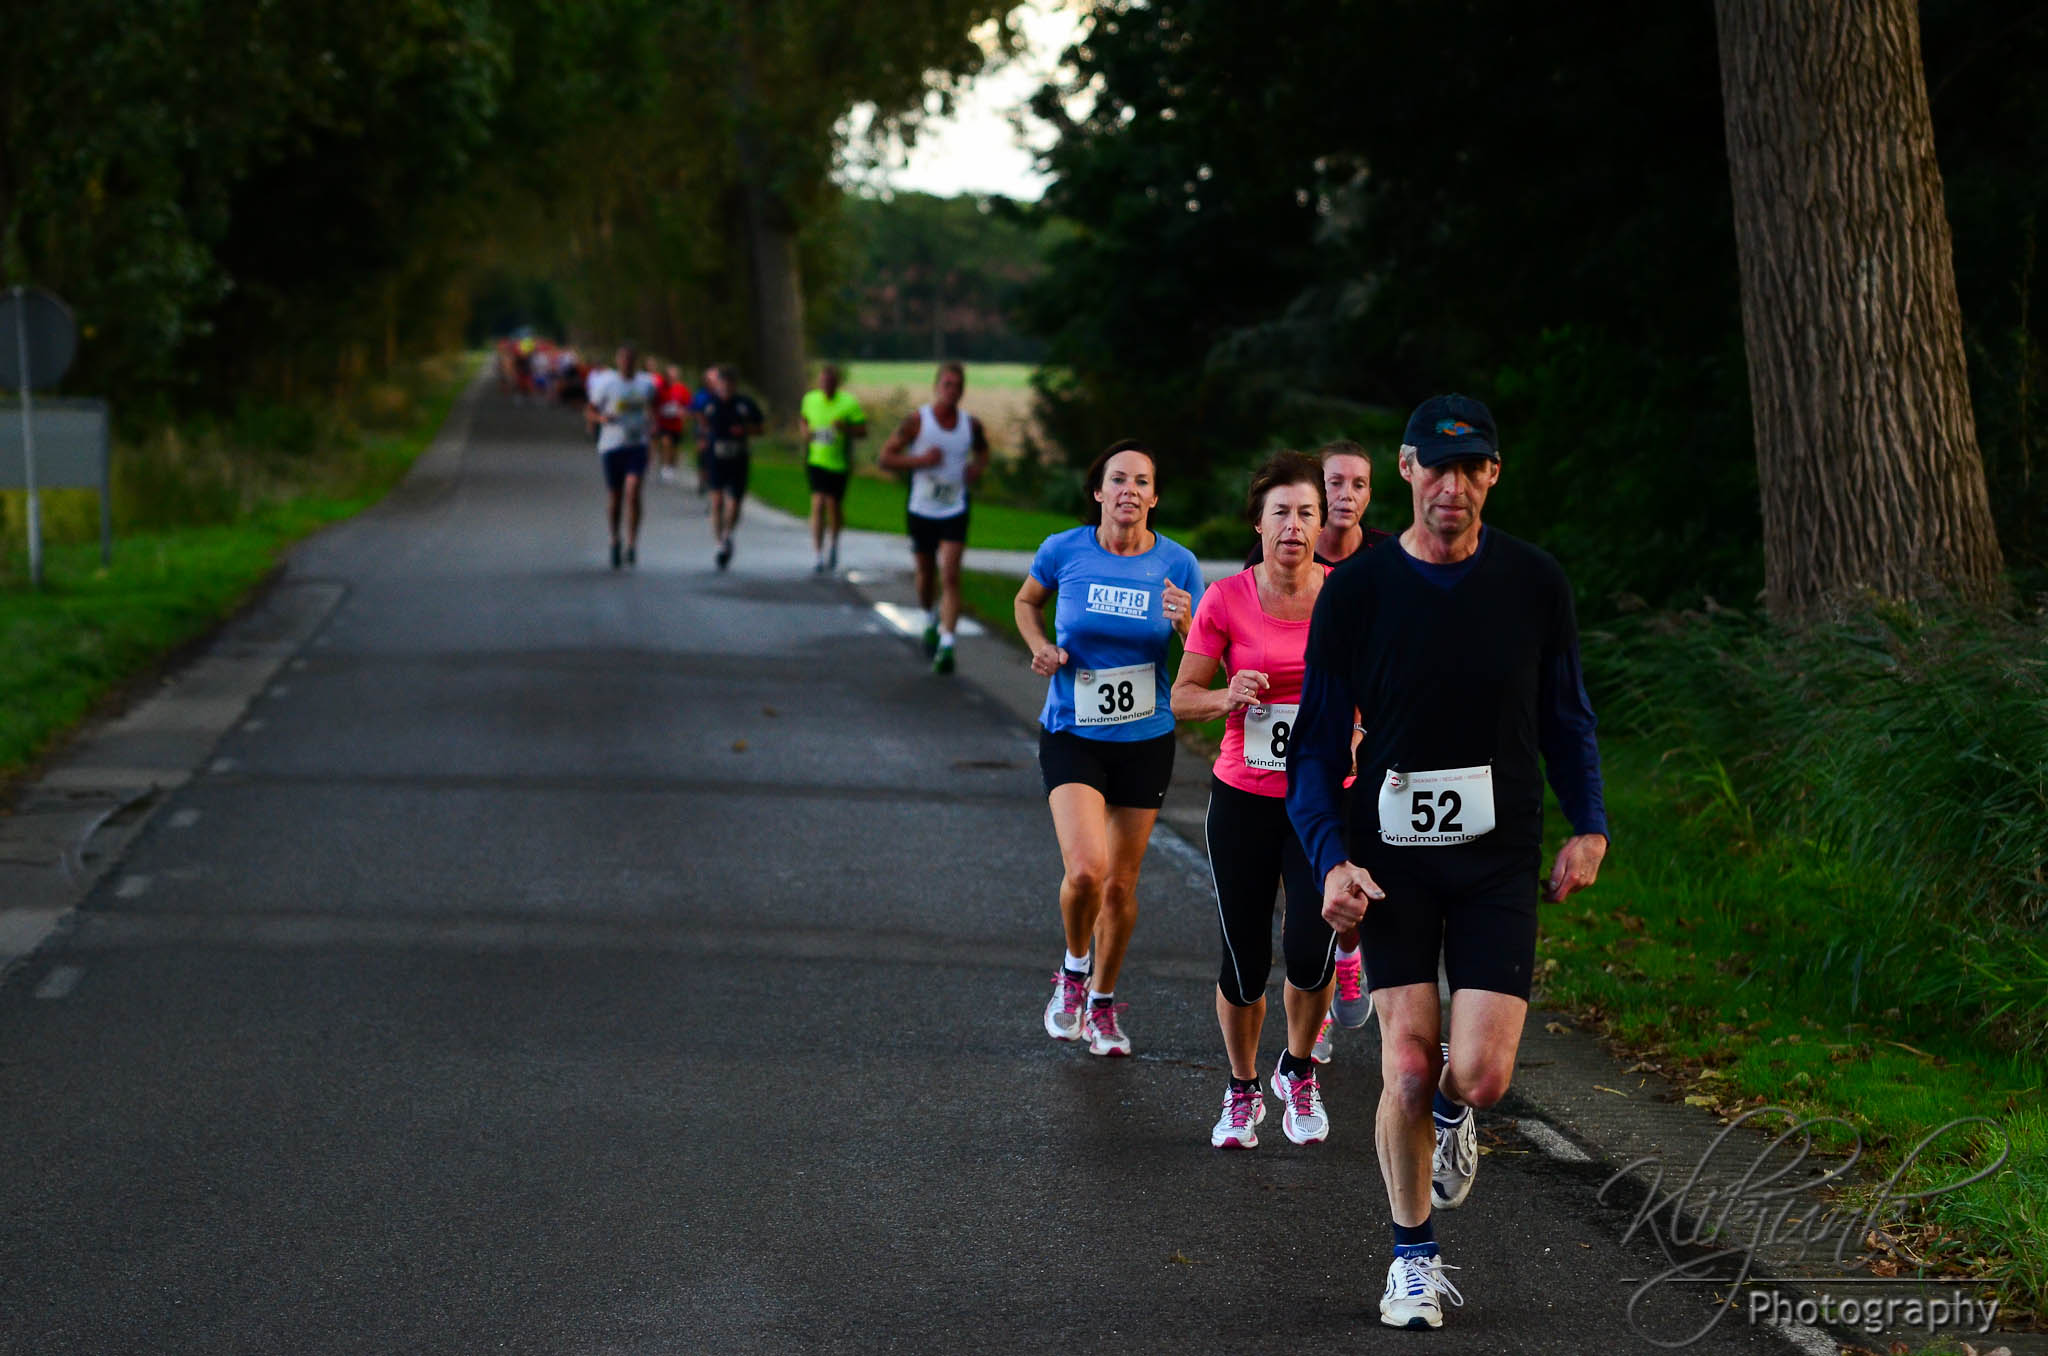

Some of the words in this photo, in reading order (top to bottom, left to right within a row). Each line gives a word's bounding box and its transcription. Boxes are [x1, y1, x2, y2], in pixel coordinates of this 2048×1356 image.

[1098, 681, 1134, 715] 38
[1078, 708, 1154, 724] windmolenloop
[1411, 790, 1463, 833] 52
